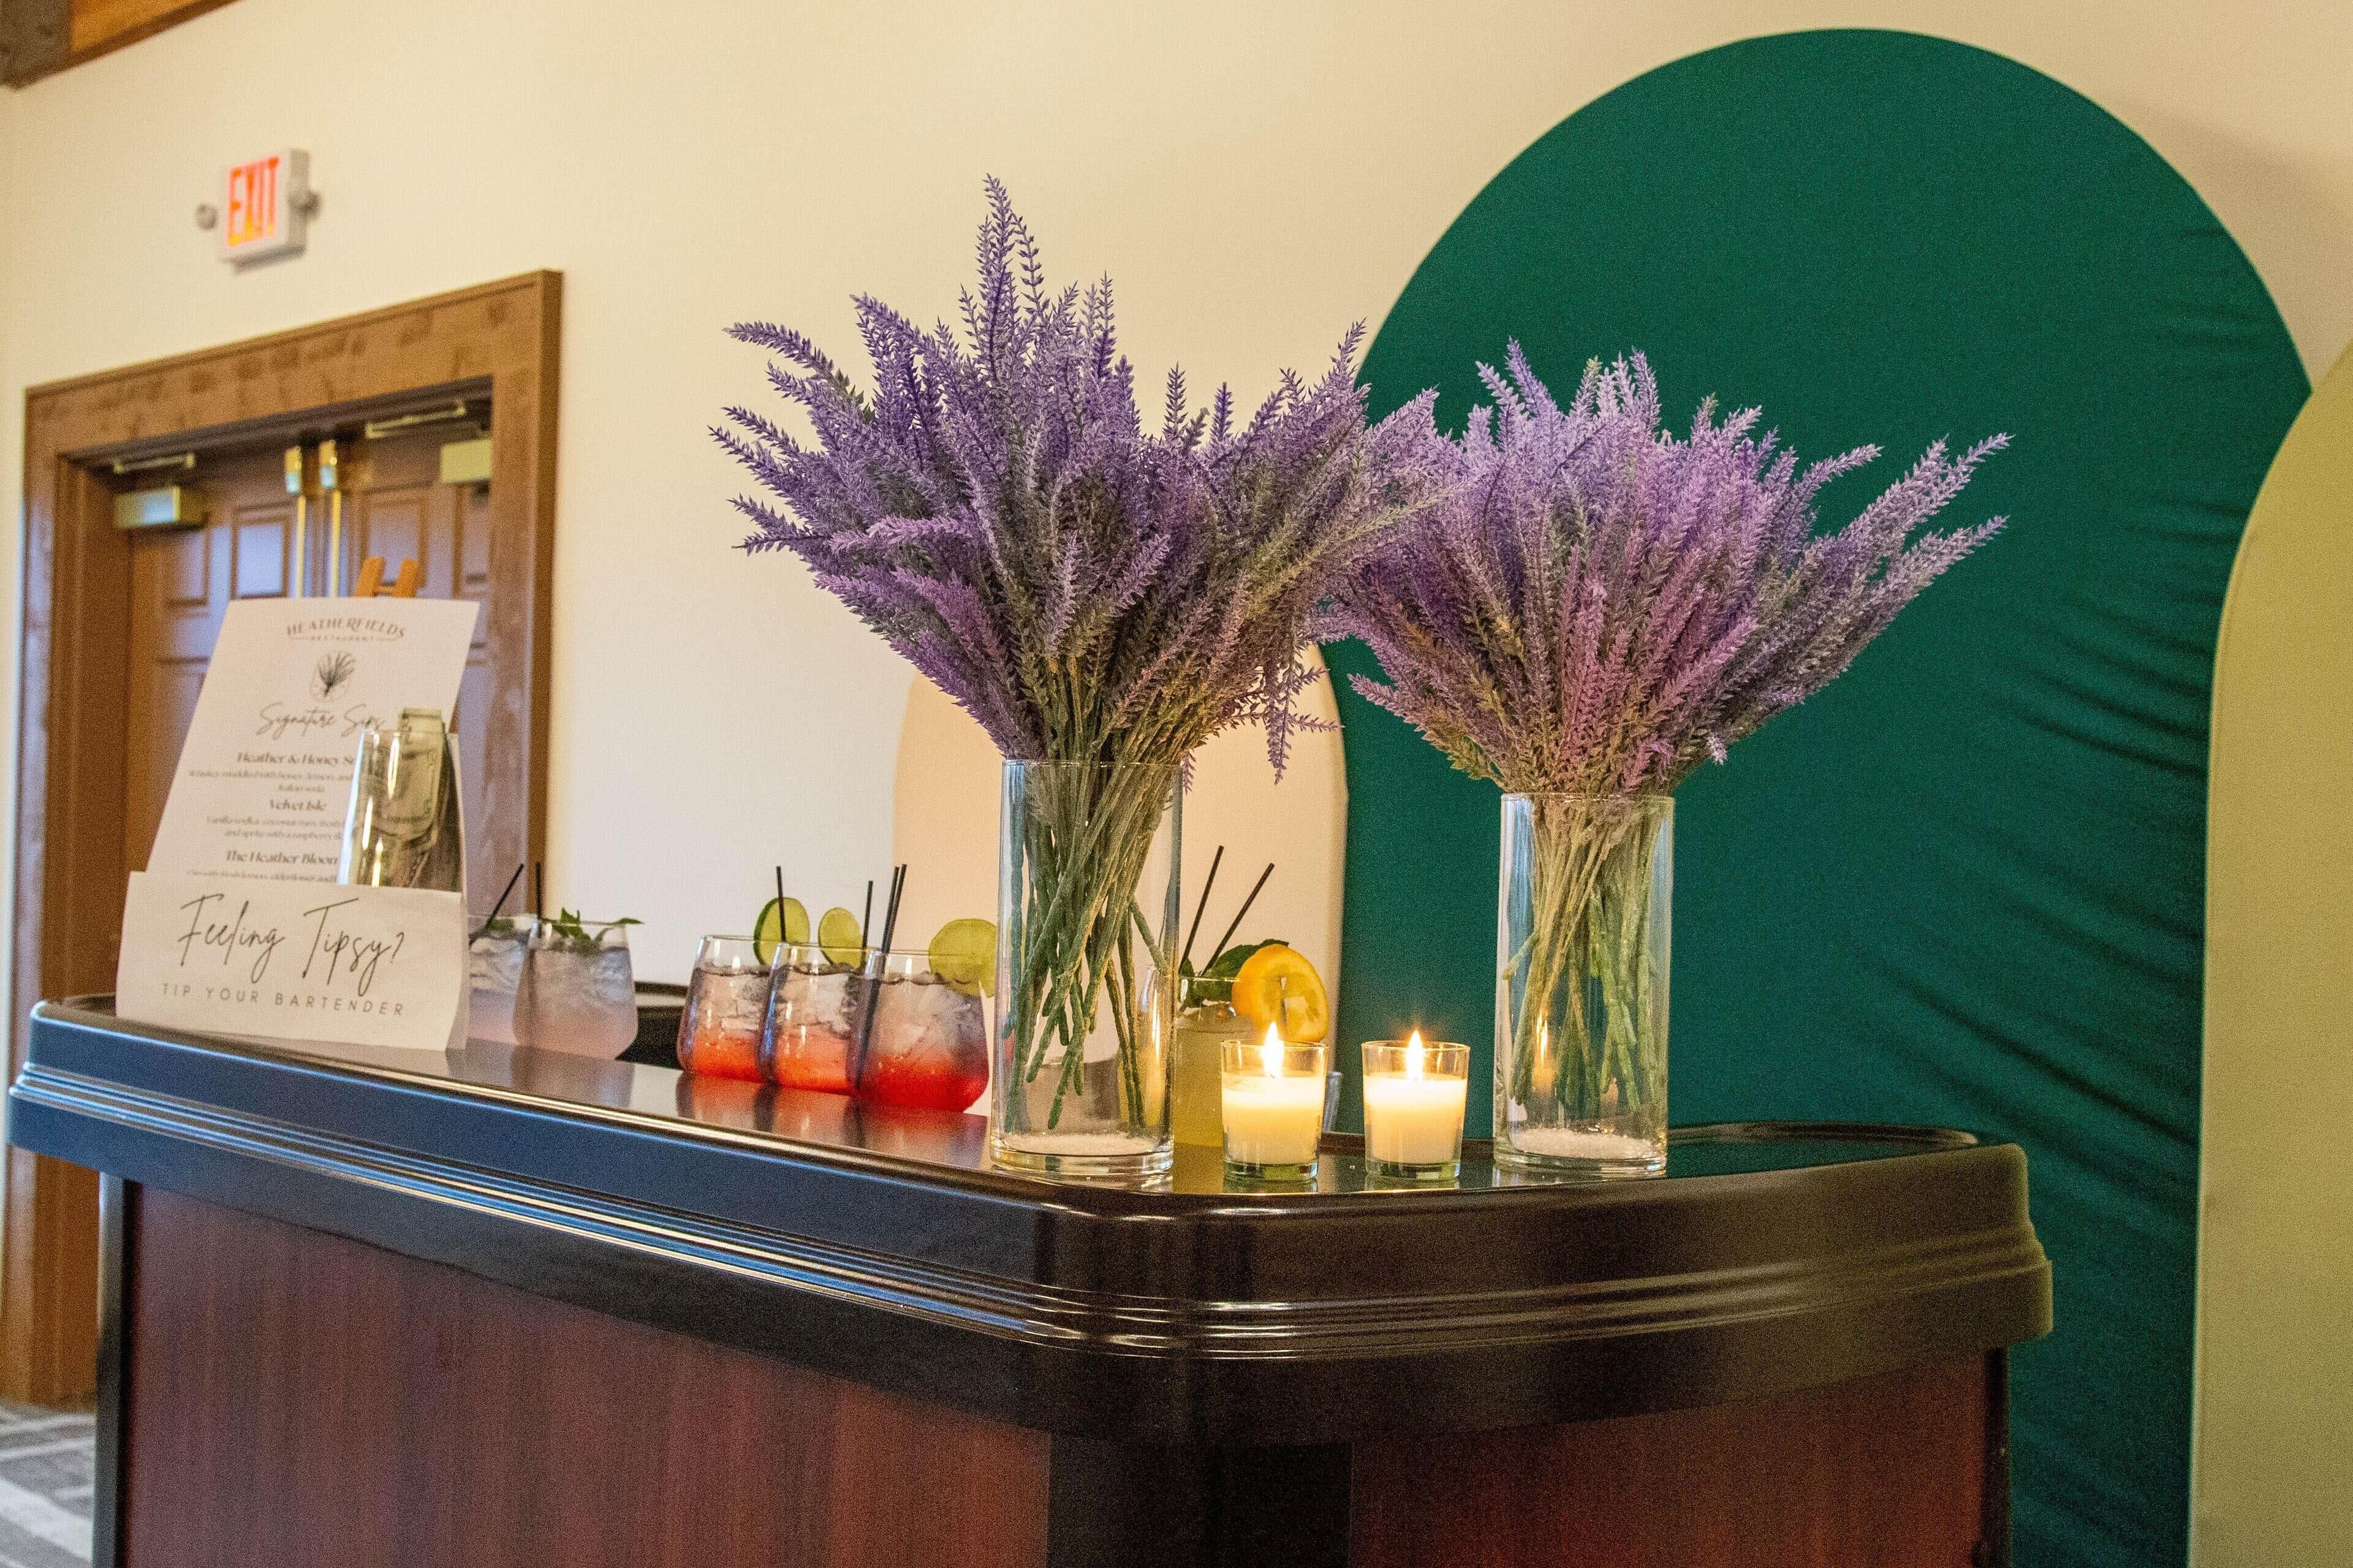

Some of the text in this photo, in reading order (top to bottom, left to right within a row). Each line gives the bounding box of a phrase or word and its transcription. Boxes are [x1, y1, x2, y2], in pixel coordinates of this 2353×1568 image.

[226, 156, 280, 246] EXIT
[256, 702, 336, 740] Signature
[237, 752, 284, 763] Heather
[226, 850, 248, 862] The
[249, 850, 300, 864] Heather
[178, 893, 406, 997] Feeling Tipsy?
[162, 982, 404, 1017] TIP YOUR BARTENDER
